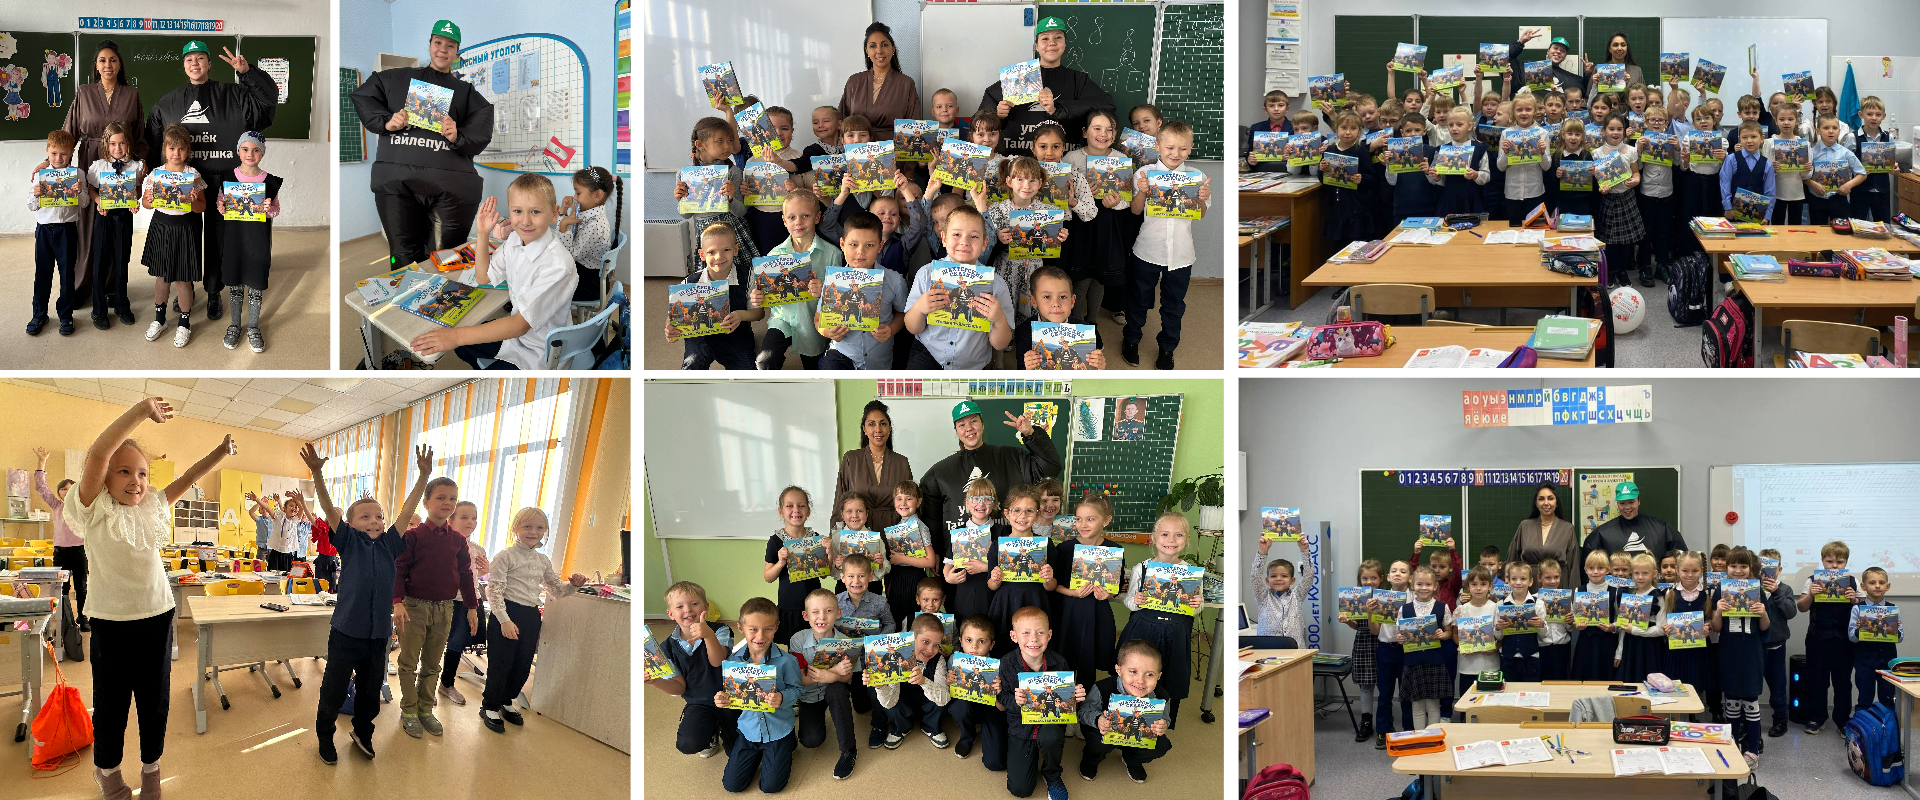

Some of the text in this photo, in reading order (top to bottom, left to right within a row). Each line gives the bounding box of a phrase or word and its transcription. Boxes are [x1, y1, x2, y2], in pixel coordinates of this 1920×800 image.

[181, 21, 187, 29] 15
[491, 43, 522, 60] УГОЛОК
[1399, 473, 1404, 483] 0
[1408, 473, 1411, 483] 1
[1415, 473, 1420, 483] 2
[1423, 473, 1427, 483] 3
[1430, 473, 1435, 483] 4
[1438, 473, 1442, 483] 5
[1445, 473, 1450, 483] 6
[1453, 473, 1458, 483] 7
[1461, 473, 1466, 483] 8
[1469, 473, 1474, 483] 9
[1476, 473, 1482, 483] 10
[1485, 473, 1491, 483] 11
[1493, 473, 1500, 483] 12
[1501, 473, 1508, 483] 13
[1510, 473, 1517, 483] 14
[1518, 473, 1525, 483] 15
[1527, 473, 1534, 483] 16
[1535, 473, 1542, 483] 17
[1552, 472, 1559, 482] 19
[1561, 472, 1568, 482] 20
